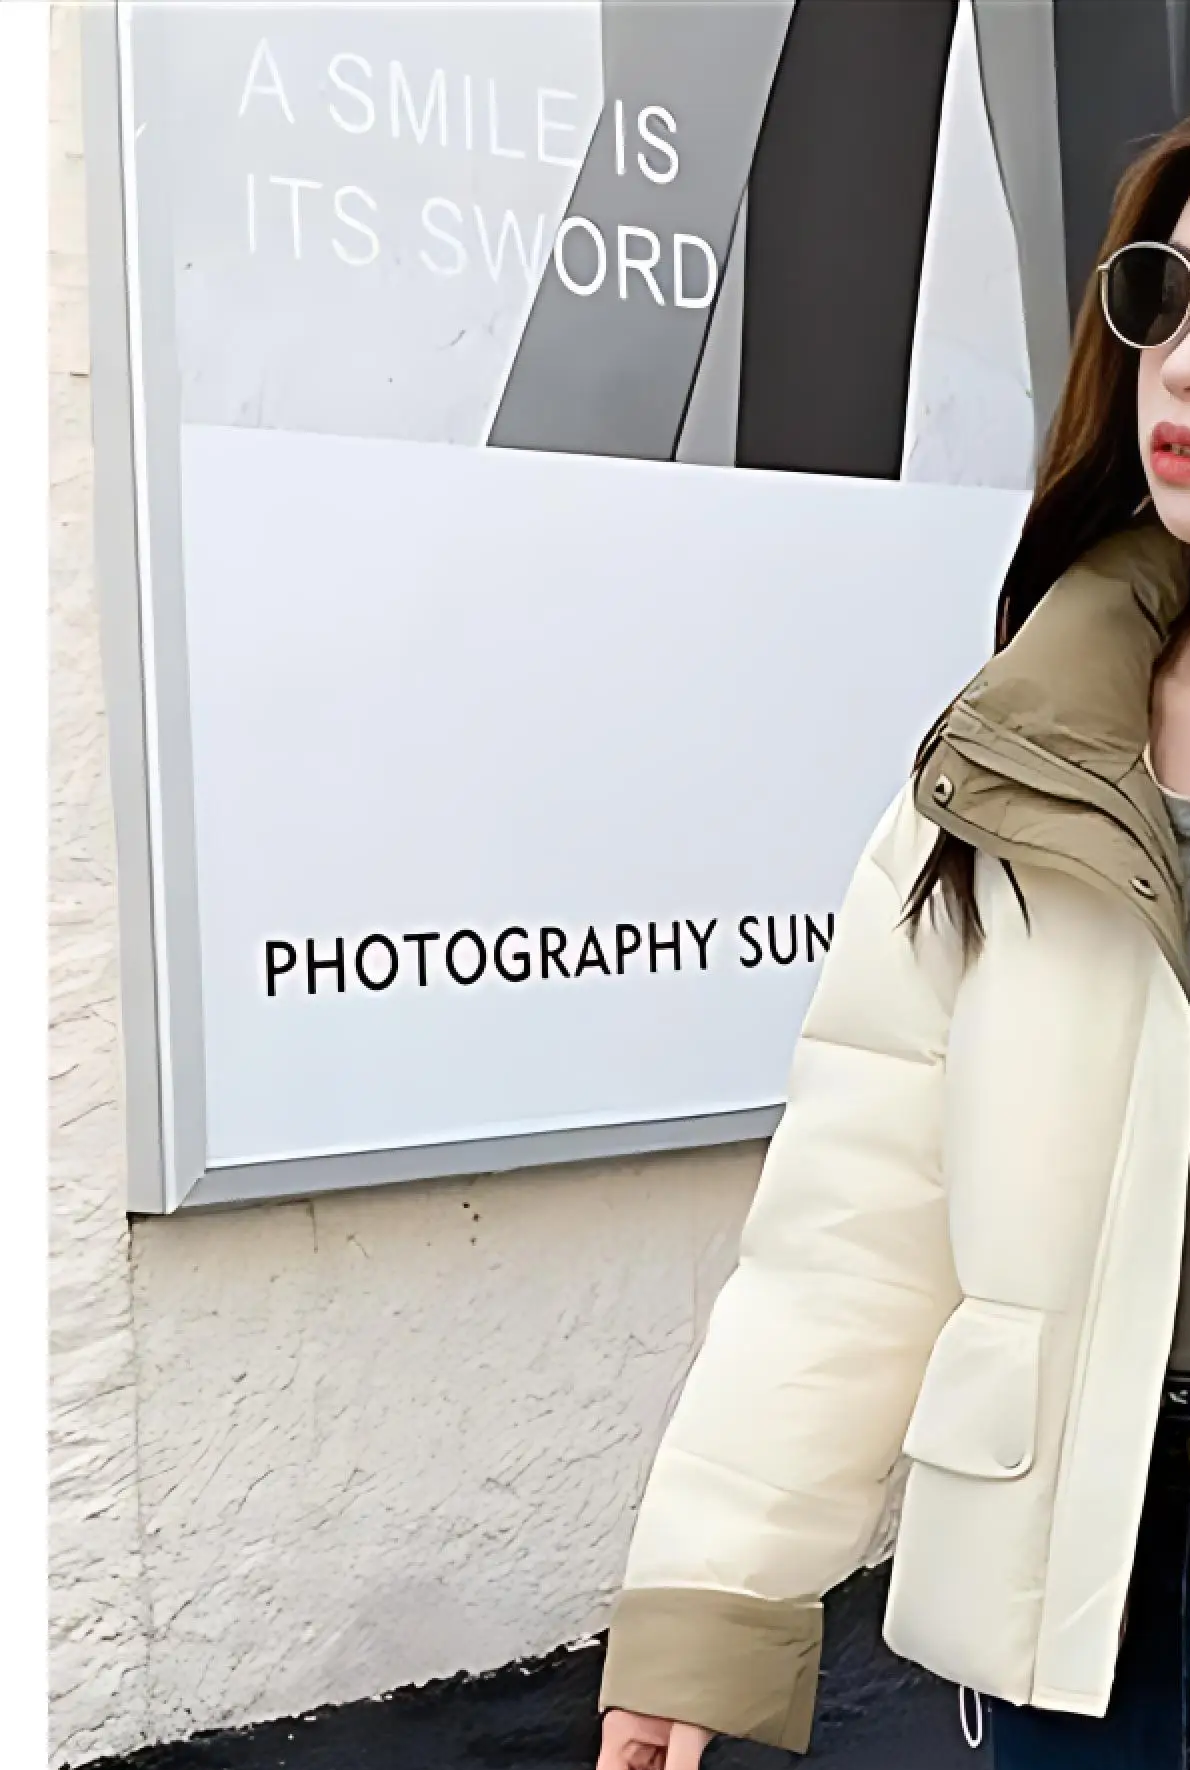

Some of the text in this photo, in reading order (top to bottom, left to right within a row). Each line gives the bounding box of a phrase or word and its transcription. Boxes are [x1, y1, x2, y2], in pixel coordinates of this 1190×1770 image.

[238, 37, 680, 185] A SMILE IS
[246, 173, 720, 310] ITS SWORD
[264, 911, 835, 996] PHOTOGRAPHY SUN
